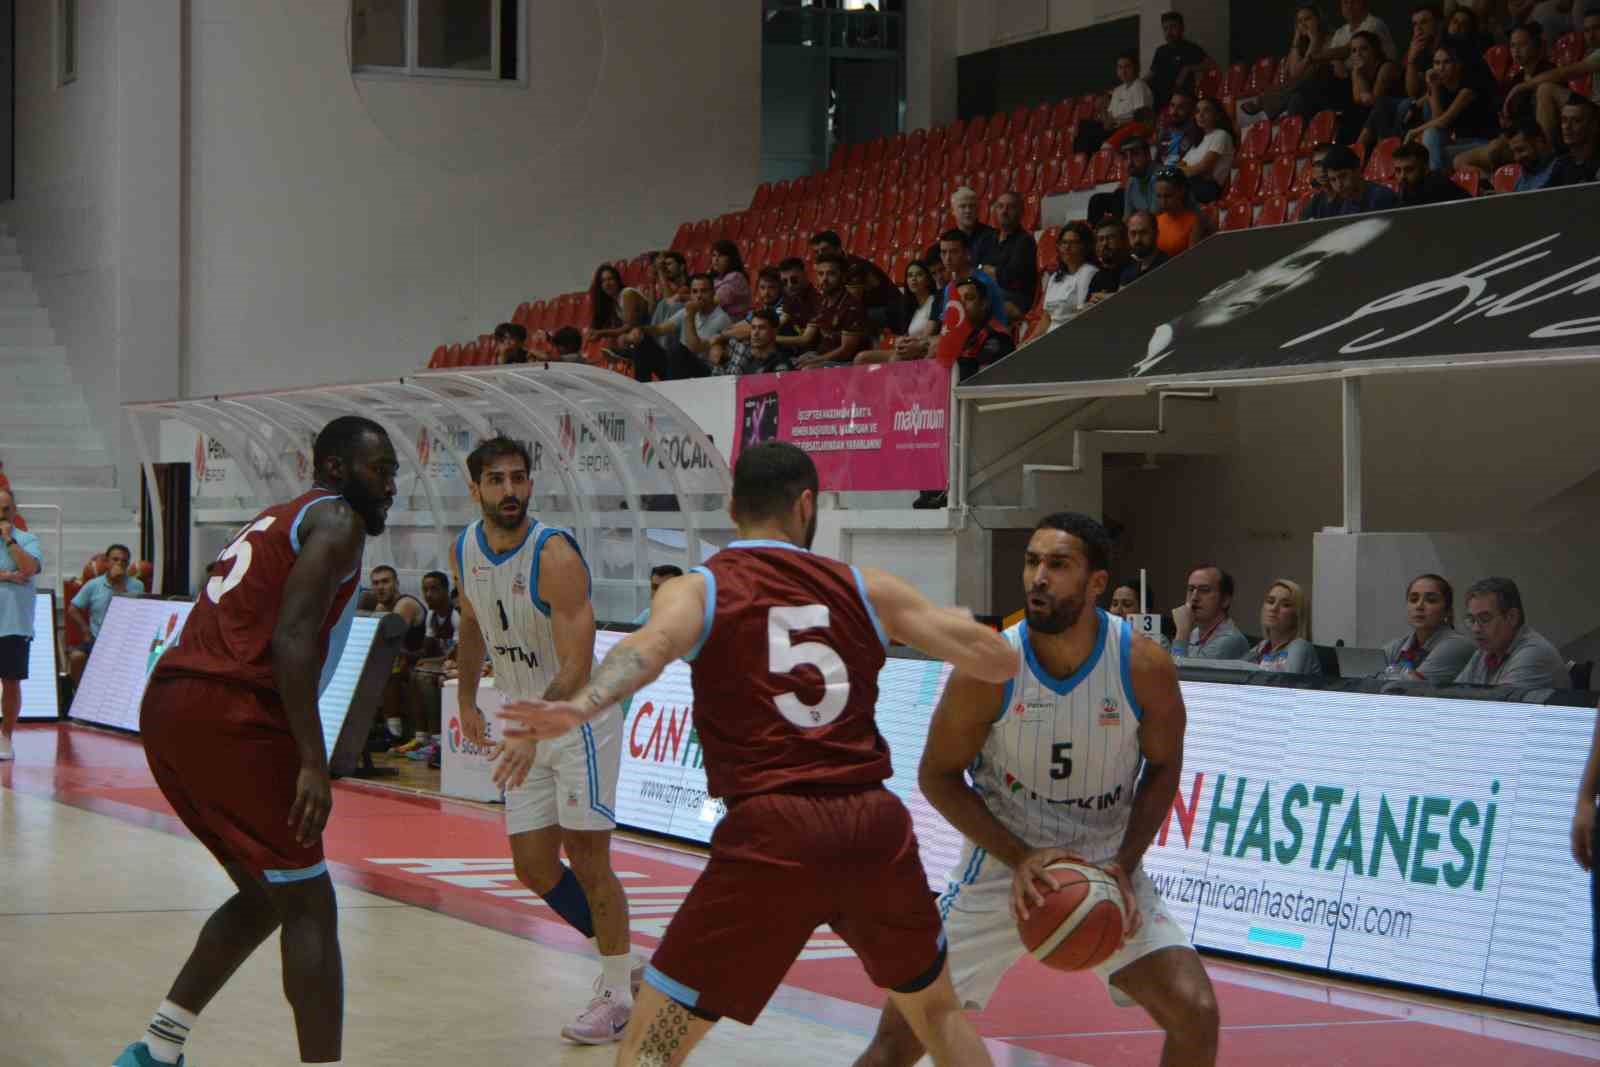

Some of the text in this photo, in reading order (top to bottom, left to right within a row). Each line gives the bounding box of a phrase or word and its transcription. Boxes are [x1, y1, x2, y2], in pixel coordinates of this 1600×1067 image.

[496, 599, 509, 631] 1
[1143, 615, 1153, 632] 3
[768, 604, 850, 728] 5
[1049, 743, 1072, 780] 5
